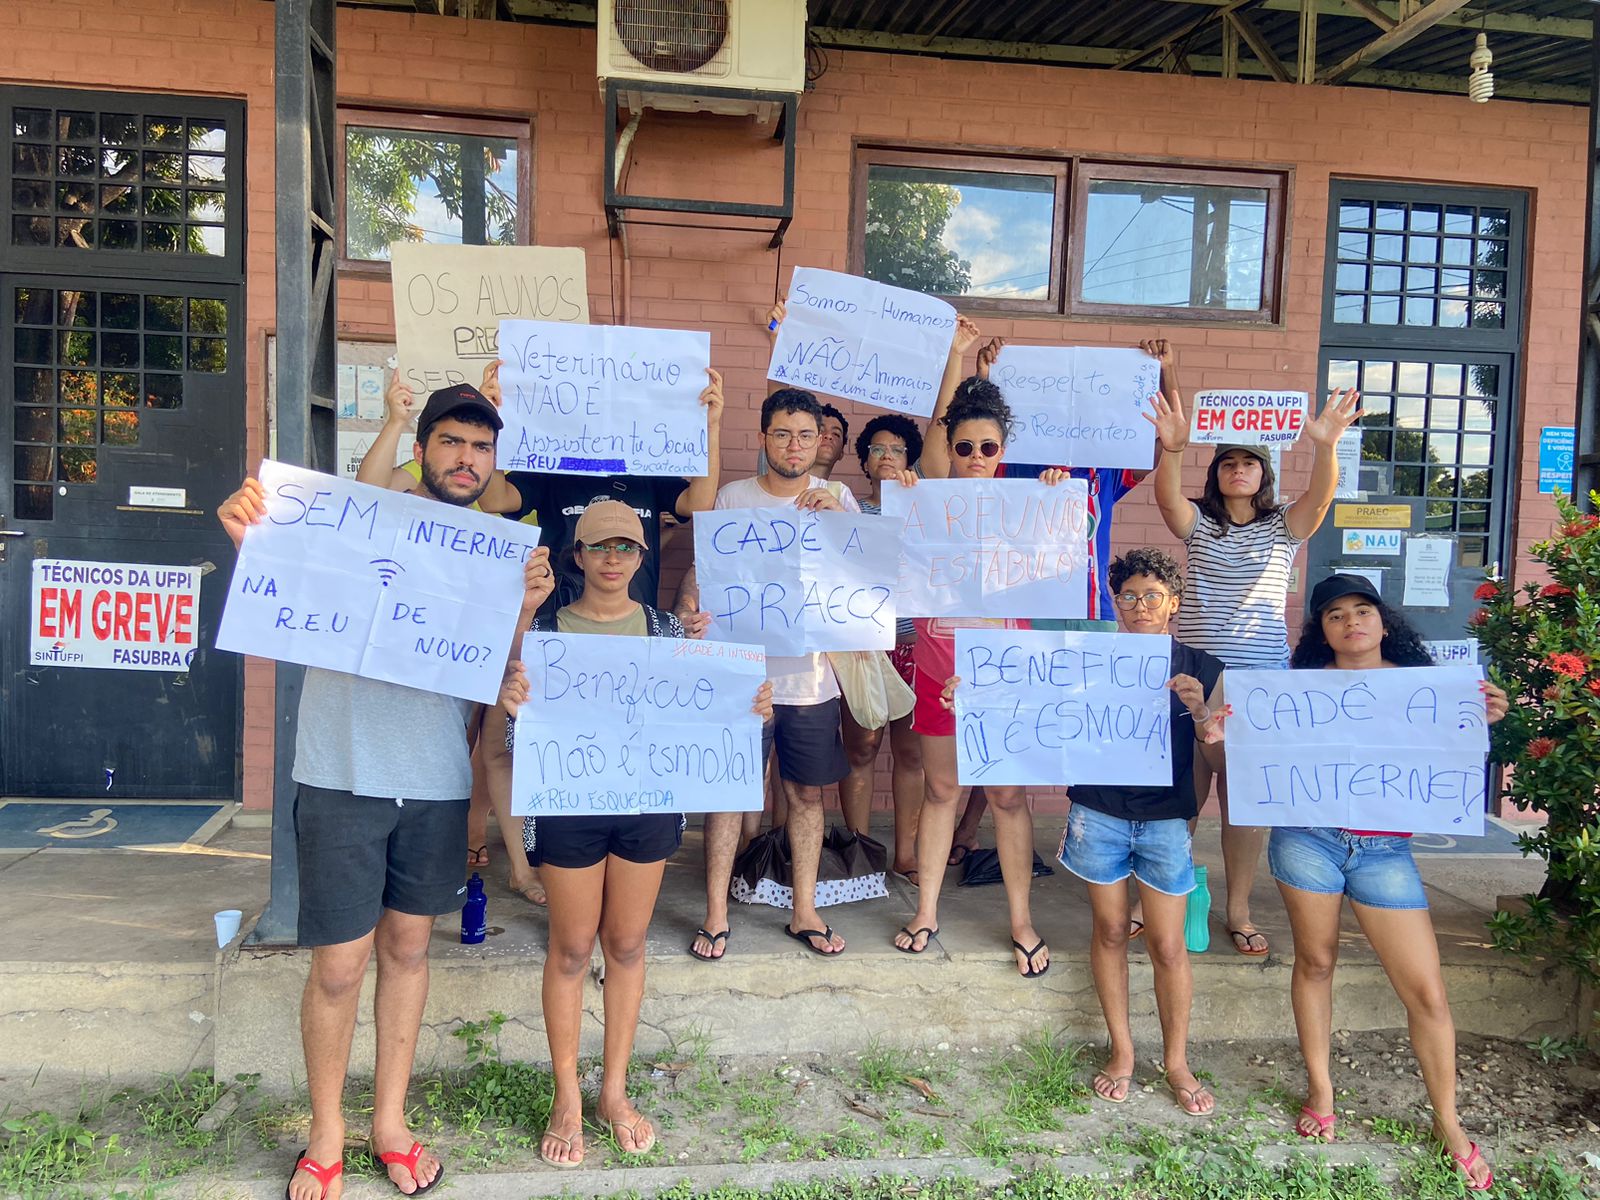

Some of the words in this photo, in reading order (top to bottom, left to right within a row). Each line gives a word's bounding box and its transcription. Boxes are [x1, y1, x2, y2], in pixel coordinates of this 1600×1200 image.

[407, 272, 459, 317] OS
[476, 274, 581, 321] ALUNOS
[792, 284, 858, 314] Somos
[881, 297, 954, 329] Humanos
[454, 326, 500, 355] PREC
[787, 336, 851, 372] NÃO
[512, 334, 681, 386] Veterinário
[516, 375, 579, 415] NÃO
[586, 380, 601, 415] É
[1200, 392, 1255, 407] TÉCNICOS
[1258, 396, 1274, 407] DA
[1277, 396, 1302, 407] UFPI
[1197, 409, 1226, 430] EM
[1231, 408, 1302, 431] GREVE
[1260, 432, 1297, 442] FASUBRA
[648, 422, 709, 458] Social
[508, 453, 557, 470] #REU
[268, 483, 379, 540] SEM
[407, 517, 533, 564] INTERNET
[904, 500, 926, 540] A
[1356, 507, 1390, 516] PRAEC
[713, 511, 822, 555] CADÊ
[842, 527, 864, 555] A
[1365, 534, 1399, 547] NAU
[41, 561, 123, 586] TÉCNICOS
[128, 569, 150, 587] DA
[155, 571, 192, 589] UFPI
[929, 541, 1074, 588] ESTÁBULO
[241, 574, 277, 598] NA
[39, 587, 83, 640] EM
[91, 589, 194, 645] GREVE
[391, 602, 427, 625] DE
[716, 581, 890, 634] PRAEC?
[35, 650, 84, 663] SINTUFPI
[113, 648, 182, 666] FASUBRA
[414, 636, 492, 669] NOVO?
[967, 645, 1169, 691] BENEFÍCIO
[1442, 644, 1471, 660] UFPI
[1246, 681, 1377, 731] CADÊ
[1406, 686, 1437, 725] A
[1004, 699, 1031, 754] É
[1034, 700, 1170, 760] ESMOLA!
[617, 731, 639, 777] é
[649, 727, 755, 785] esmola!
[528, 788, 580, 811] #REU
[590, 789, 674, 810] ESQUECIDA
[1257, 763, 1486, 825] INTERNET?
